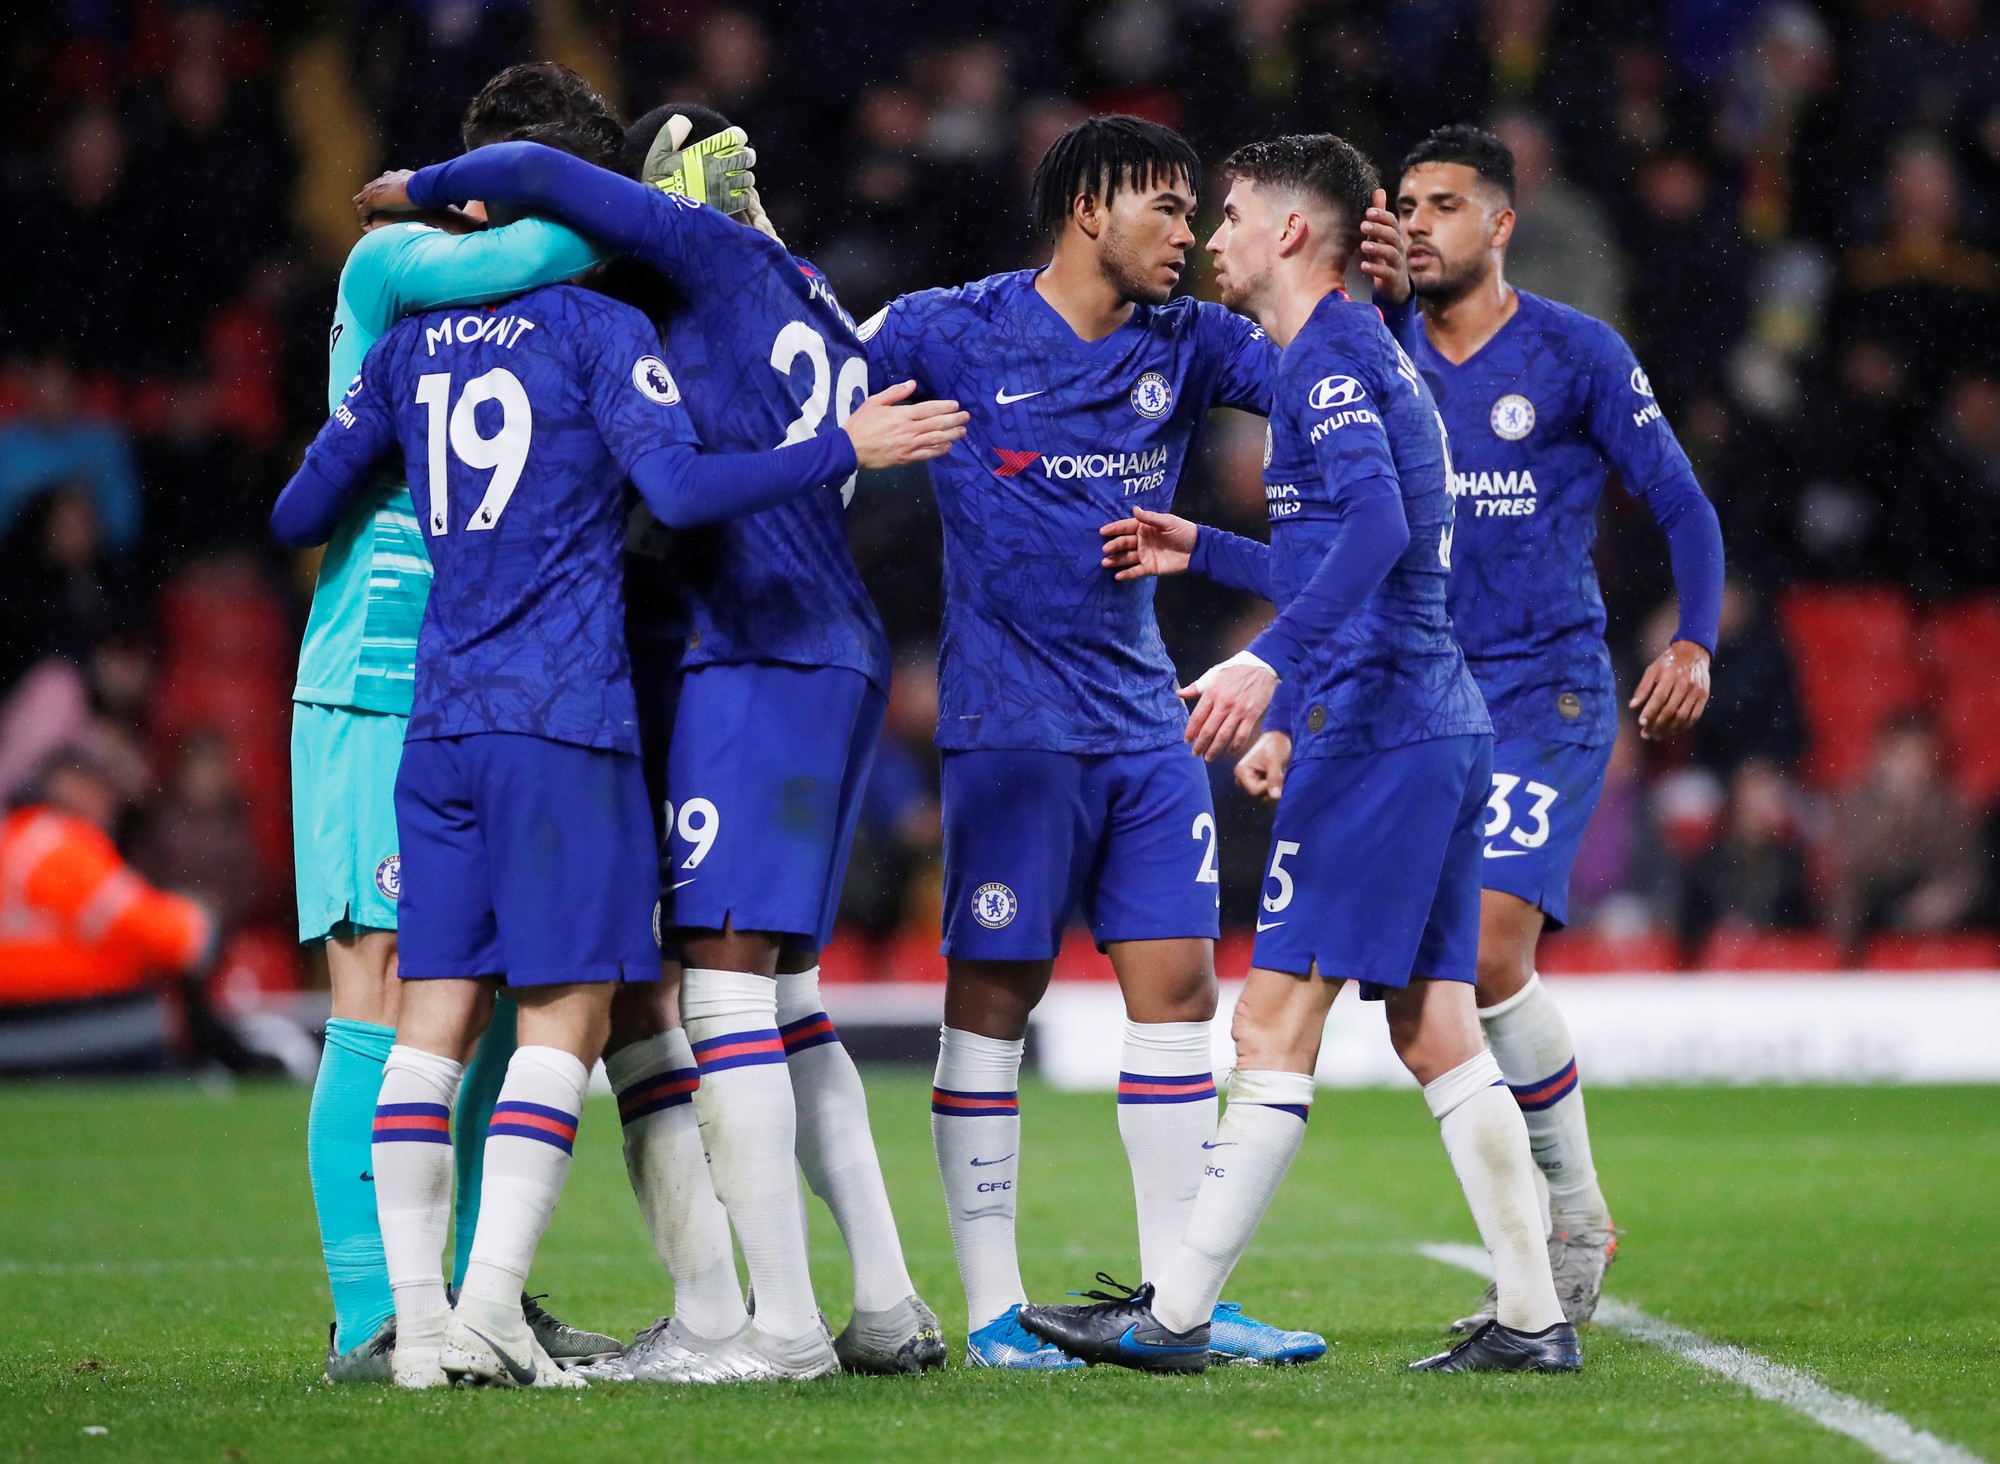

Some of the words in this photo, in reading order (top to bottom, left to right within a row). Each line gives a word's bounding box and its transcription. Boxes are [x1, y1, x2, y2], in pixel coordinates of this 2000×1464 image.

[414, 367, 533, 537] 19
[1040, 444, 1167, 480] YOKOHAMA
[1122, 469, 1166, 496] TYRES
[1474, 497, 1537, 517] TYRES
[1484, 773, 1559, 849] 33
[978, 884, 1008, 895] CHELSEA
[1262, 839, 1301, 913] 5
[1204, 1165, 1225, 1178] CFC
[977, 1180, 1012, 1193] CFC
